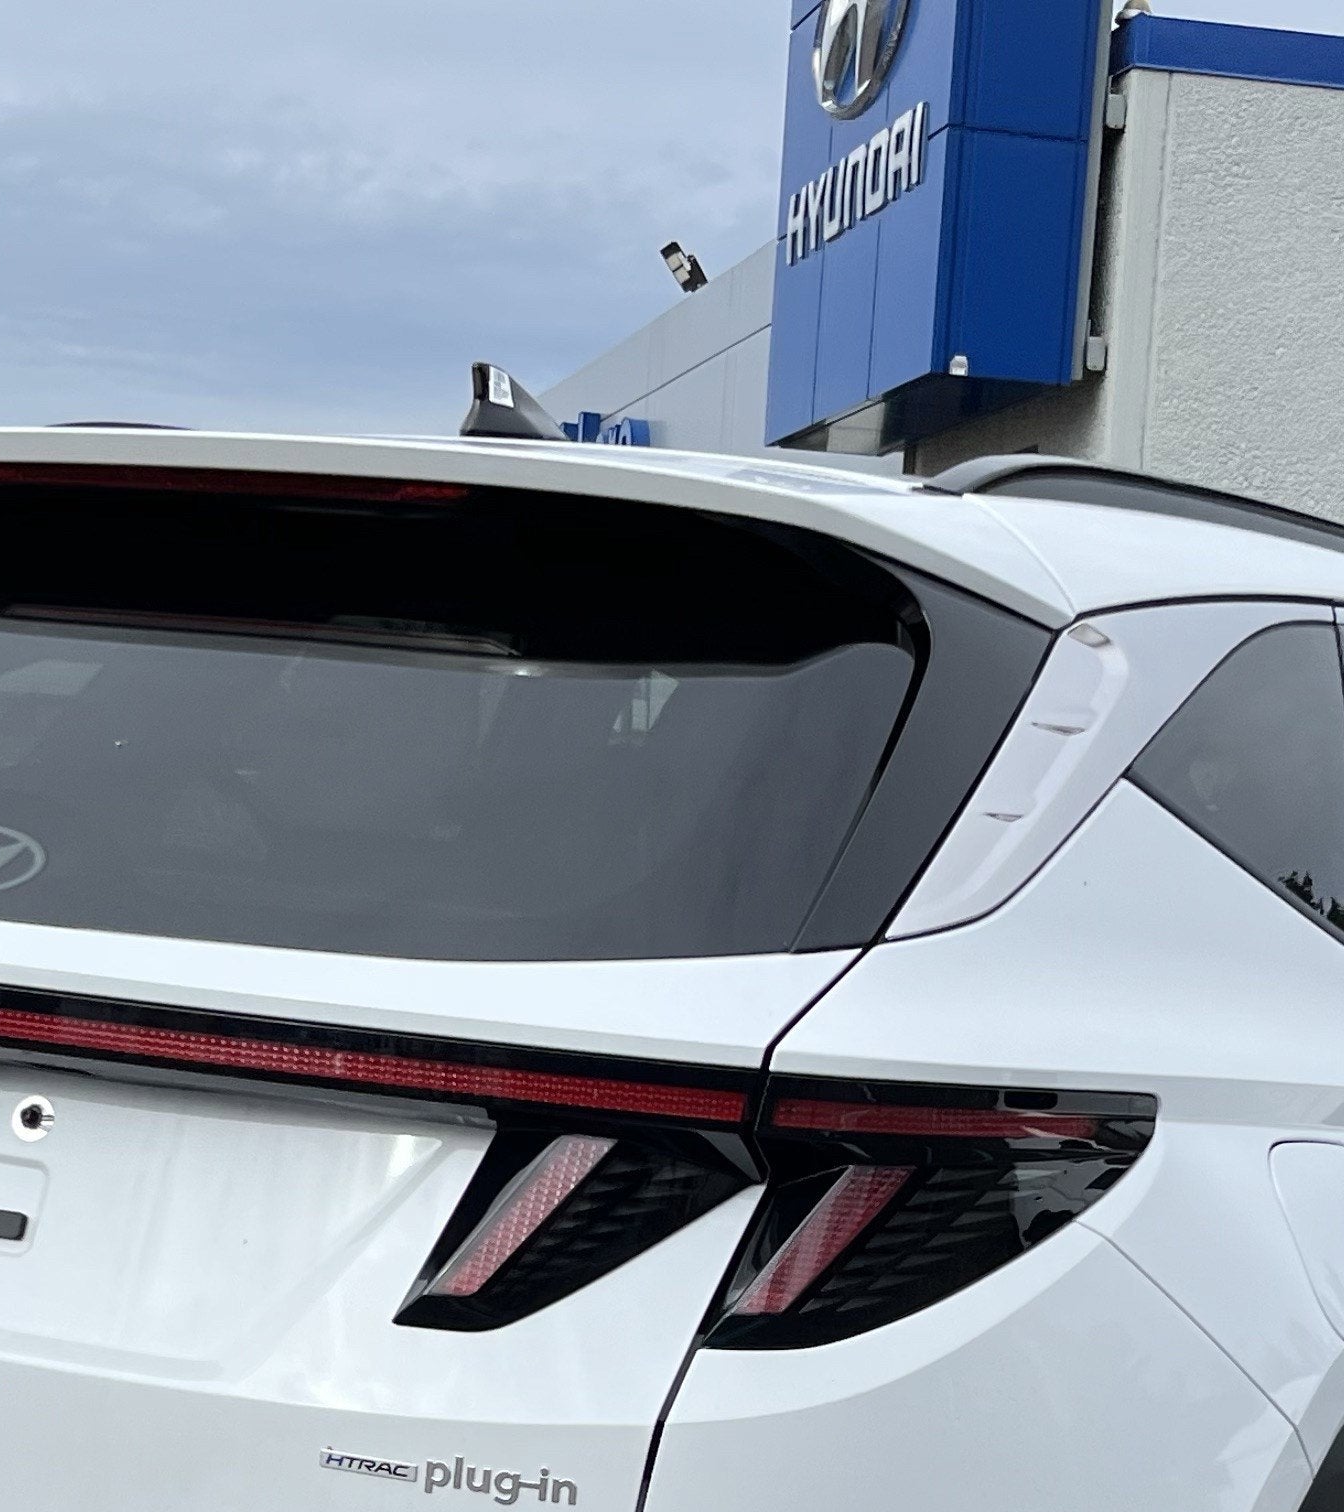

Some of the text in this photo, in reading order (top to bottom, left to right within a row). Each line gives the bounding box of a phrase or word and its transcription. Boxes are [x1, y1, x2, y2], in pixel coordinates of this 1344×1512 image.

[785, 101, 929, 266] HYUNDAI
[324, 1452, 578, 1506] HTRAC plug-in
